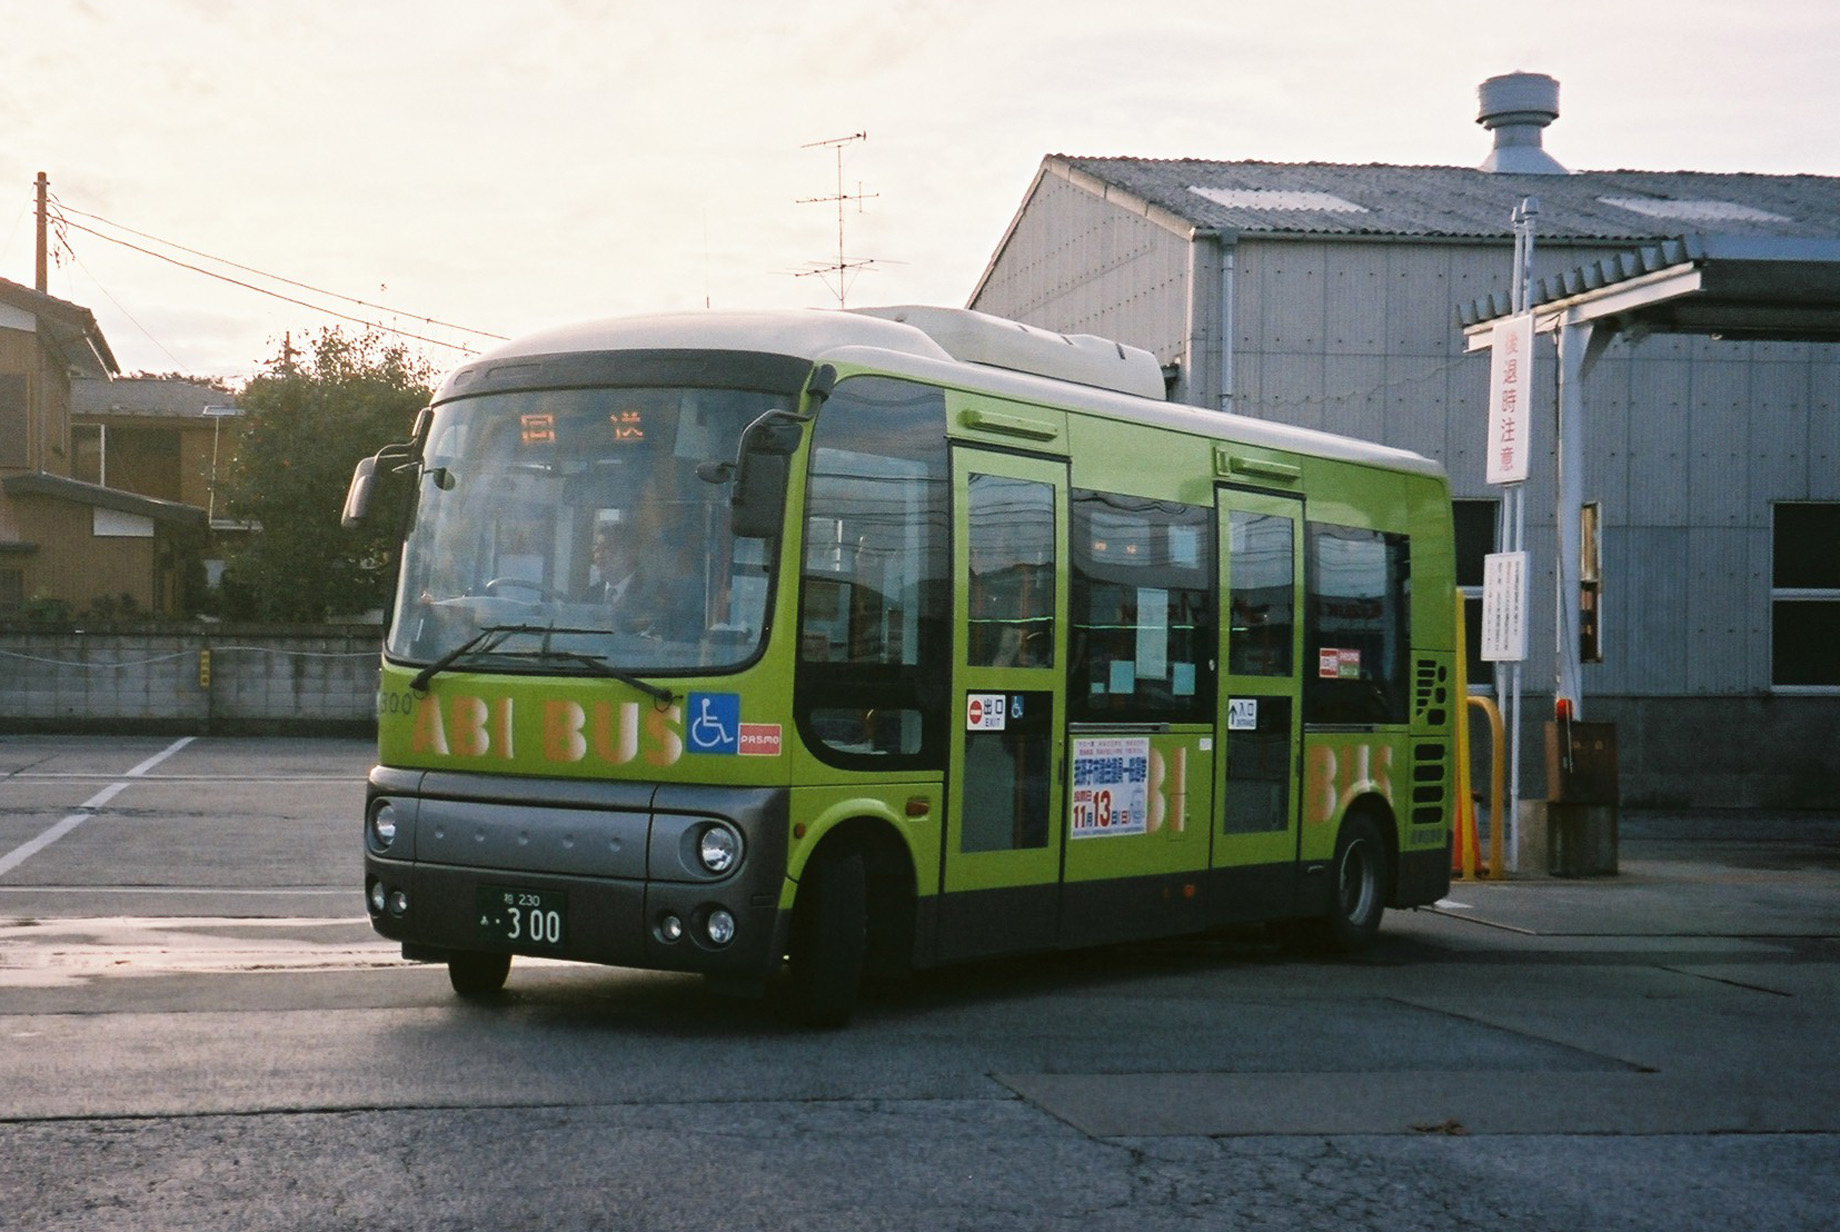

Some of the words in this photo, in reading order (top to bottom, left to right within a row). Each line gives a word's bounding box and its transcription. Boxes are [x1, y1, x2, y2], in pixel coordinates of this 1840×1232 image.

[984, 699, 1003, 715] 出口
[1239, 702, 1254, 717] 入口
[985, 717, 1001, 728] EXIT
[411, 695, 514, 759] ABI
[544, 698, 683, 767] BUS
[740, 734, 780, 746] PASMO
[519, 894, 541, 907] 230
